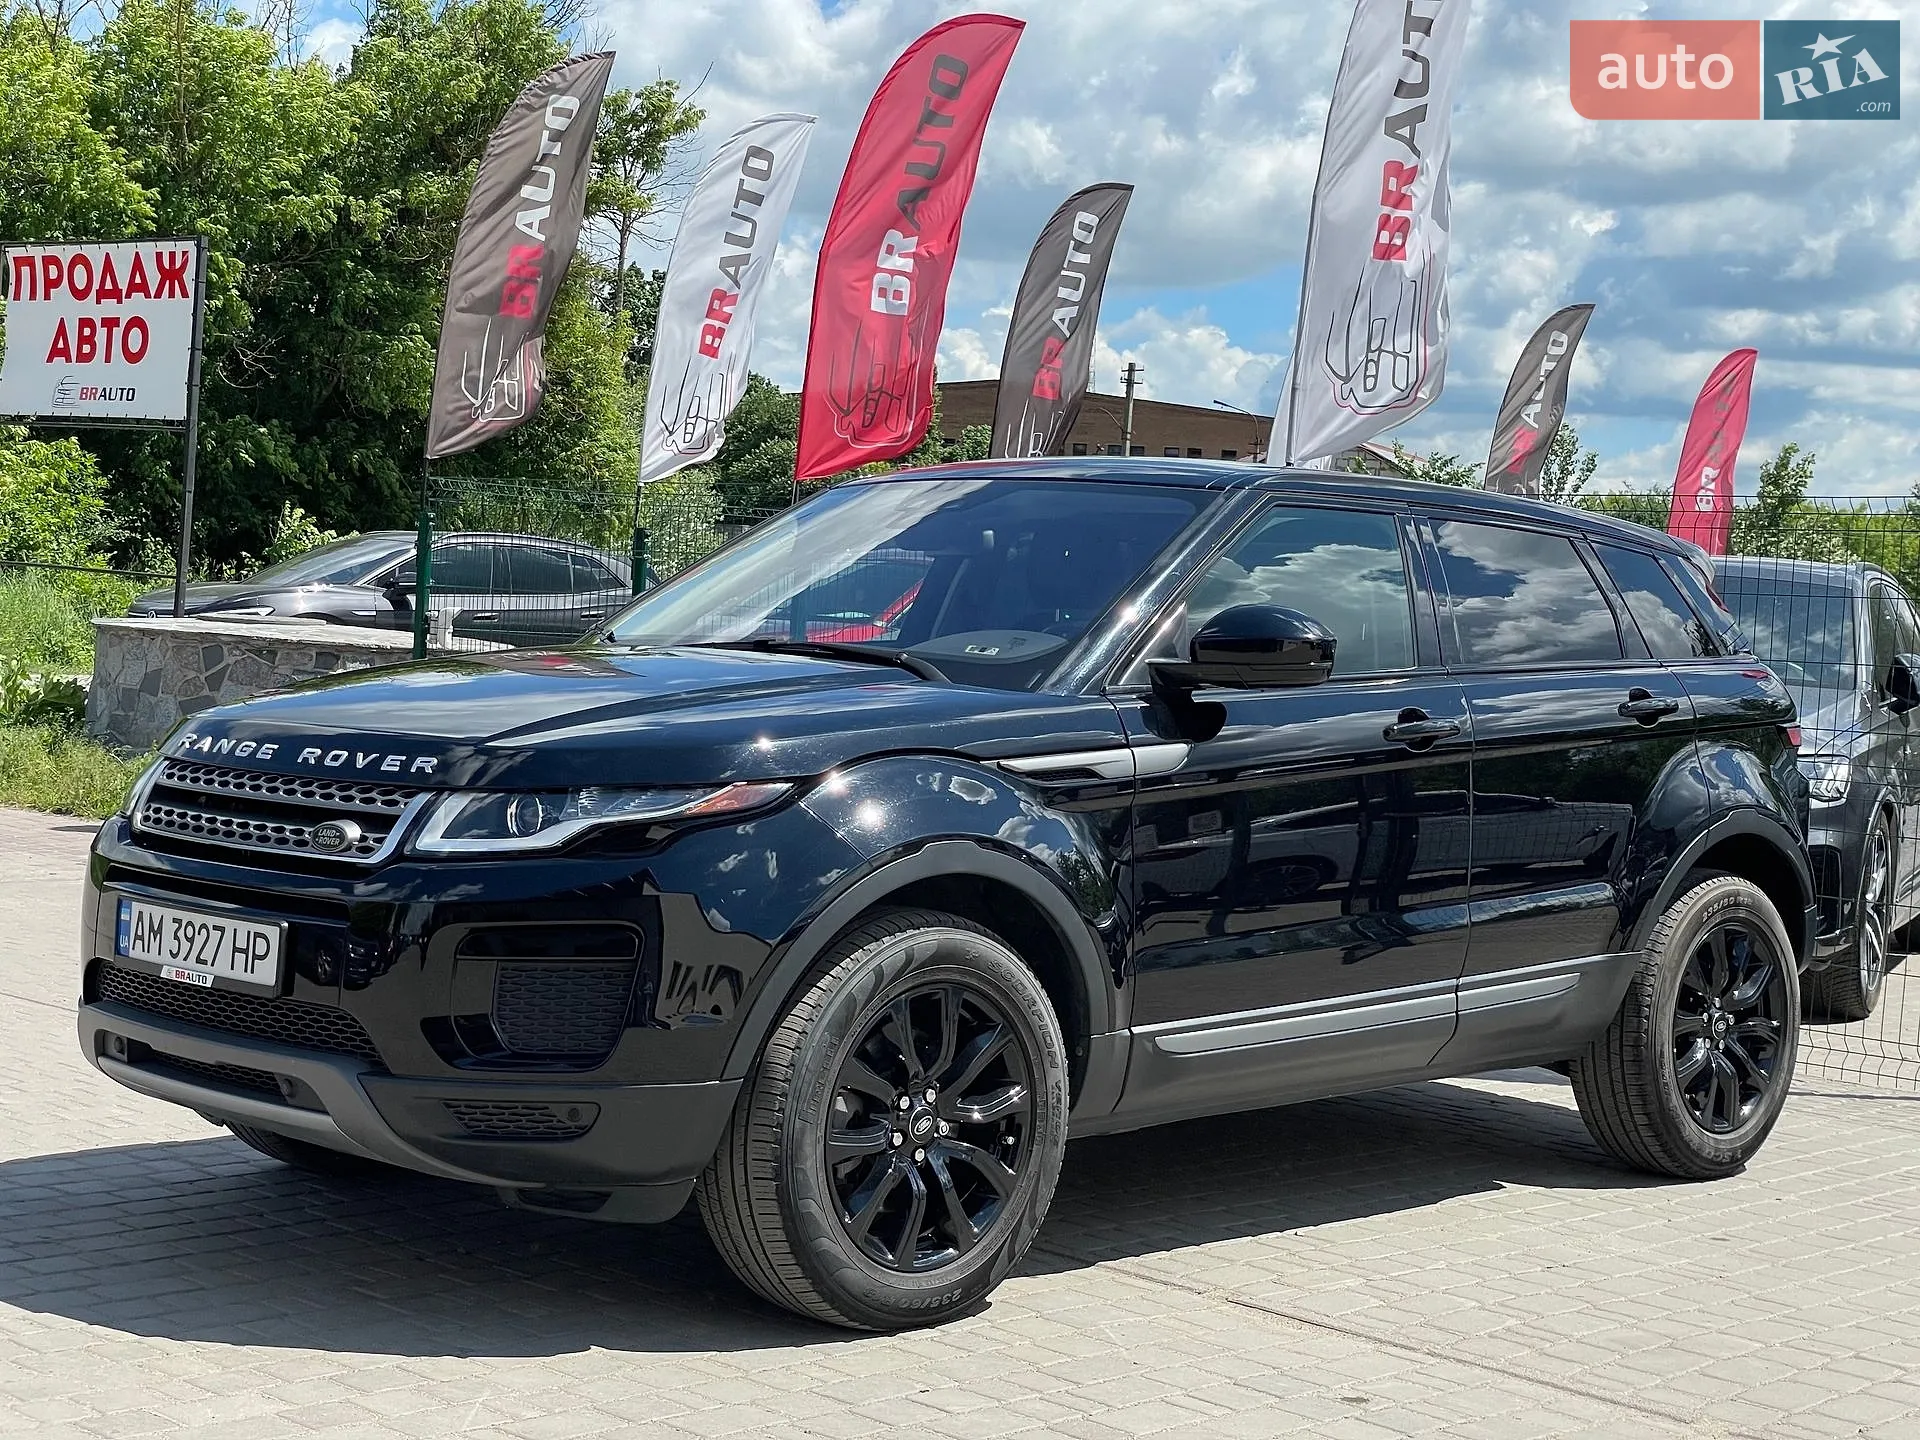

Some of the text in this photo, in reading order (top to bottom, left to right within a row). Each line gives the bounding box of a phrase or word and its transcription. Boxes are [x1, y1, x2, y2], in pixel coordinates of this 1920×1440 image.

[1373, 0, 1439, 261] BRAUT
[500, 94, 580, 319] BRAUTO
[870, 54, 968, 316] BRAUTO
[12, 250, 190, 305] ПРОДАЖ
[698, 144, 776, 361] BRAUTO
[1031, 210, 1101, 400] BRAUTO
[45, 315, 150, 365] АВТО
[78, 386, 136, 402] BRAUTO
[178, 732, 439, 774] RANGE ROVER
[318, 829, 337, 837] LAND
[318, 836, 340, 846] ROVER
[119, 936, 129, 948] UA
[132, 911, 271, 975] AM 3927 HP
[174, 969, 208, 985] BRAUTO
[988, 959, 1060, 1068] SCORPION
